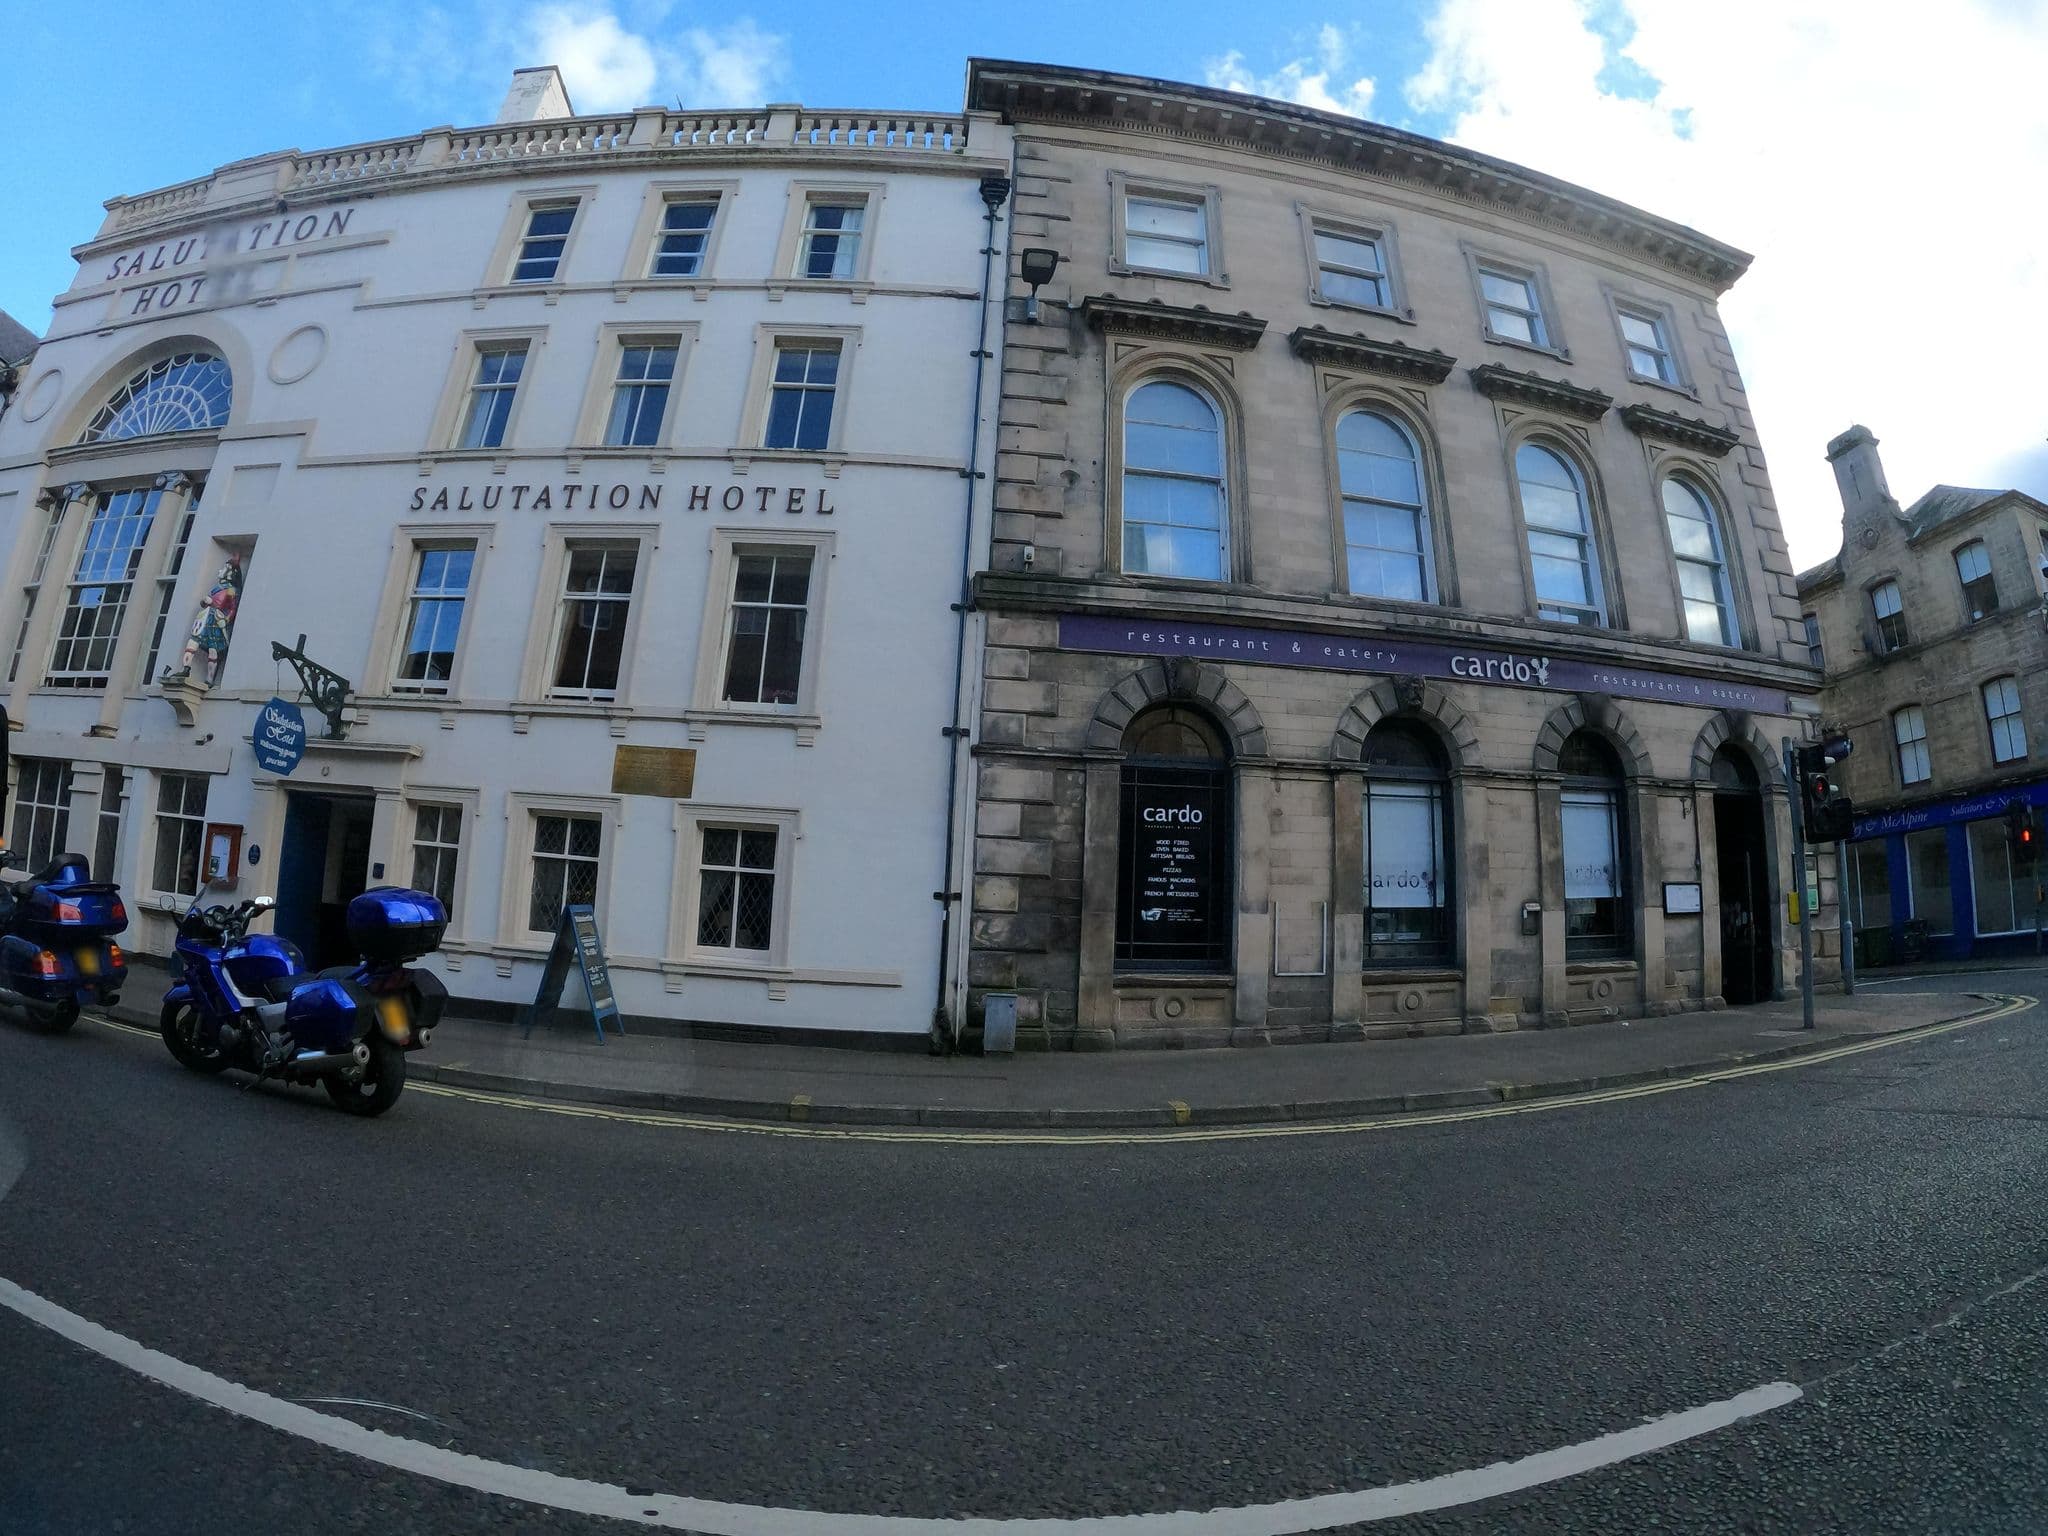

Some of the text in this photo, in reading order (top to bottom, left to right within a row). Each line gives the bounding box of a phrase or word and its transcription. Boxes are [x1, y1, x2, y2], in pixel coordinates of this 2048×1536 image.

[105, 208, 355, 281] SALUTION
[410, 485, 835, 515] SALUTATION HOTEL
[1128, 630, 1397, 663] restaurant & eatery
[1451, 654, 1531, 682] cardo
[1594, 673, 1757, 703] restaurant & eatery
[1143, 804, 1202, 823] cardo
[1881, 810, 1929, 829] McAlpine
